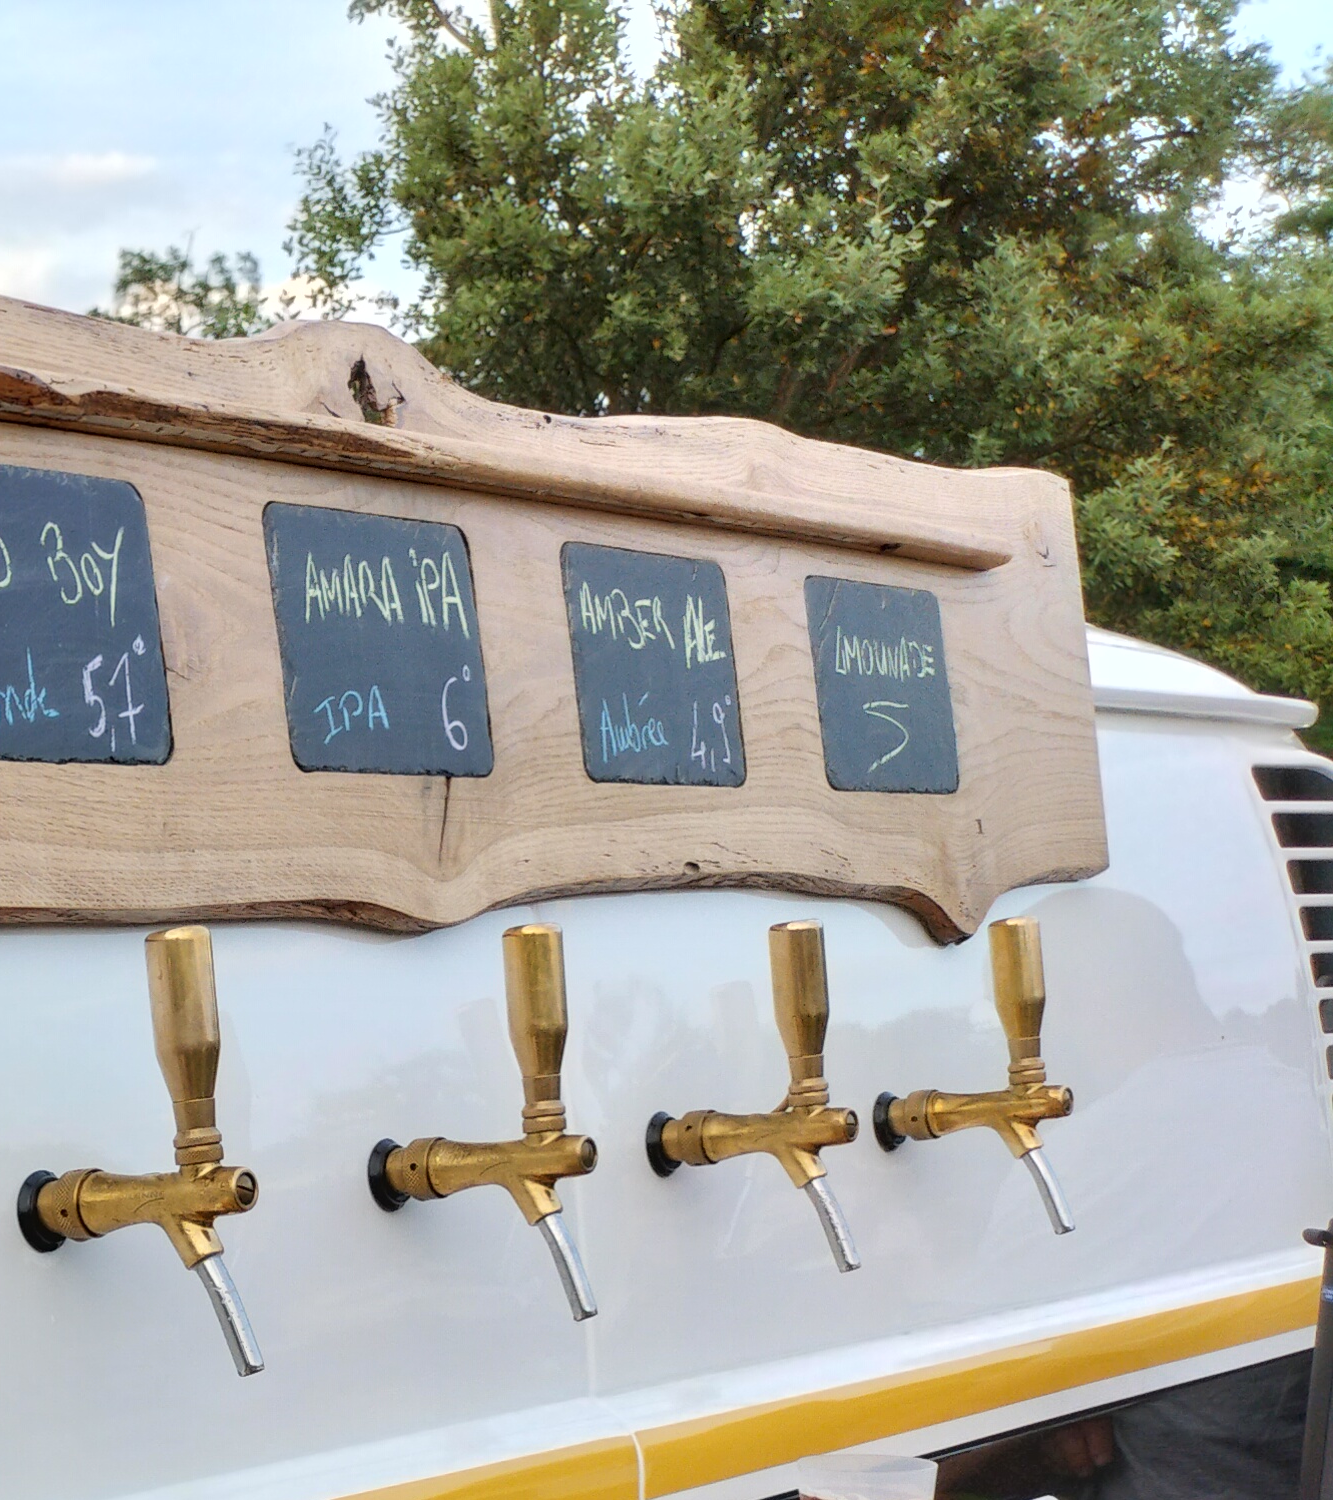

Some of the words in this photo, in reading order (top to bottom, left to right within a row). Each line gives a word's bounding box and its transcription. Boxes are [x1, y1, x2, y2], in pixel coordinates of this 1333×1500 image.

[40, 521, 124, 627] BOY
[304, 552, 404, 625] AMARA
[579, 581, 675, 649] AMBER
[313, 685, 391, 744] IPA
